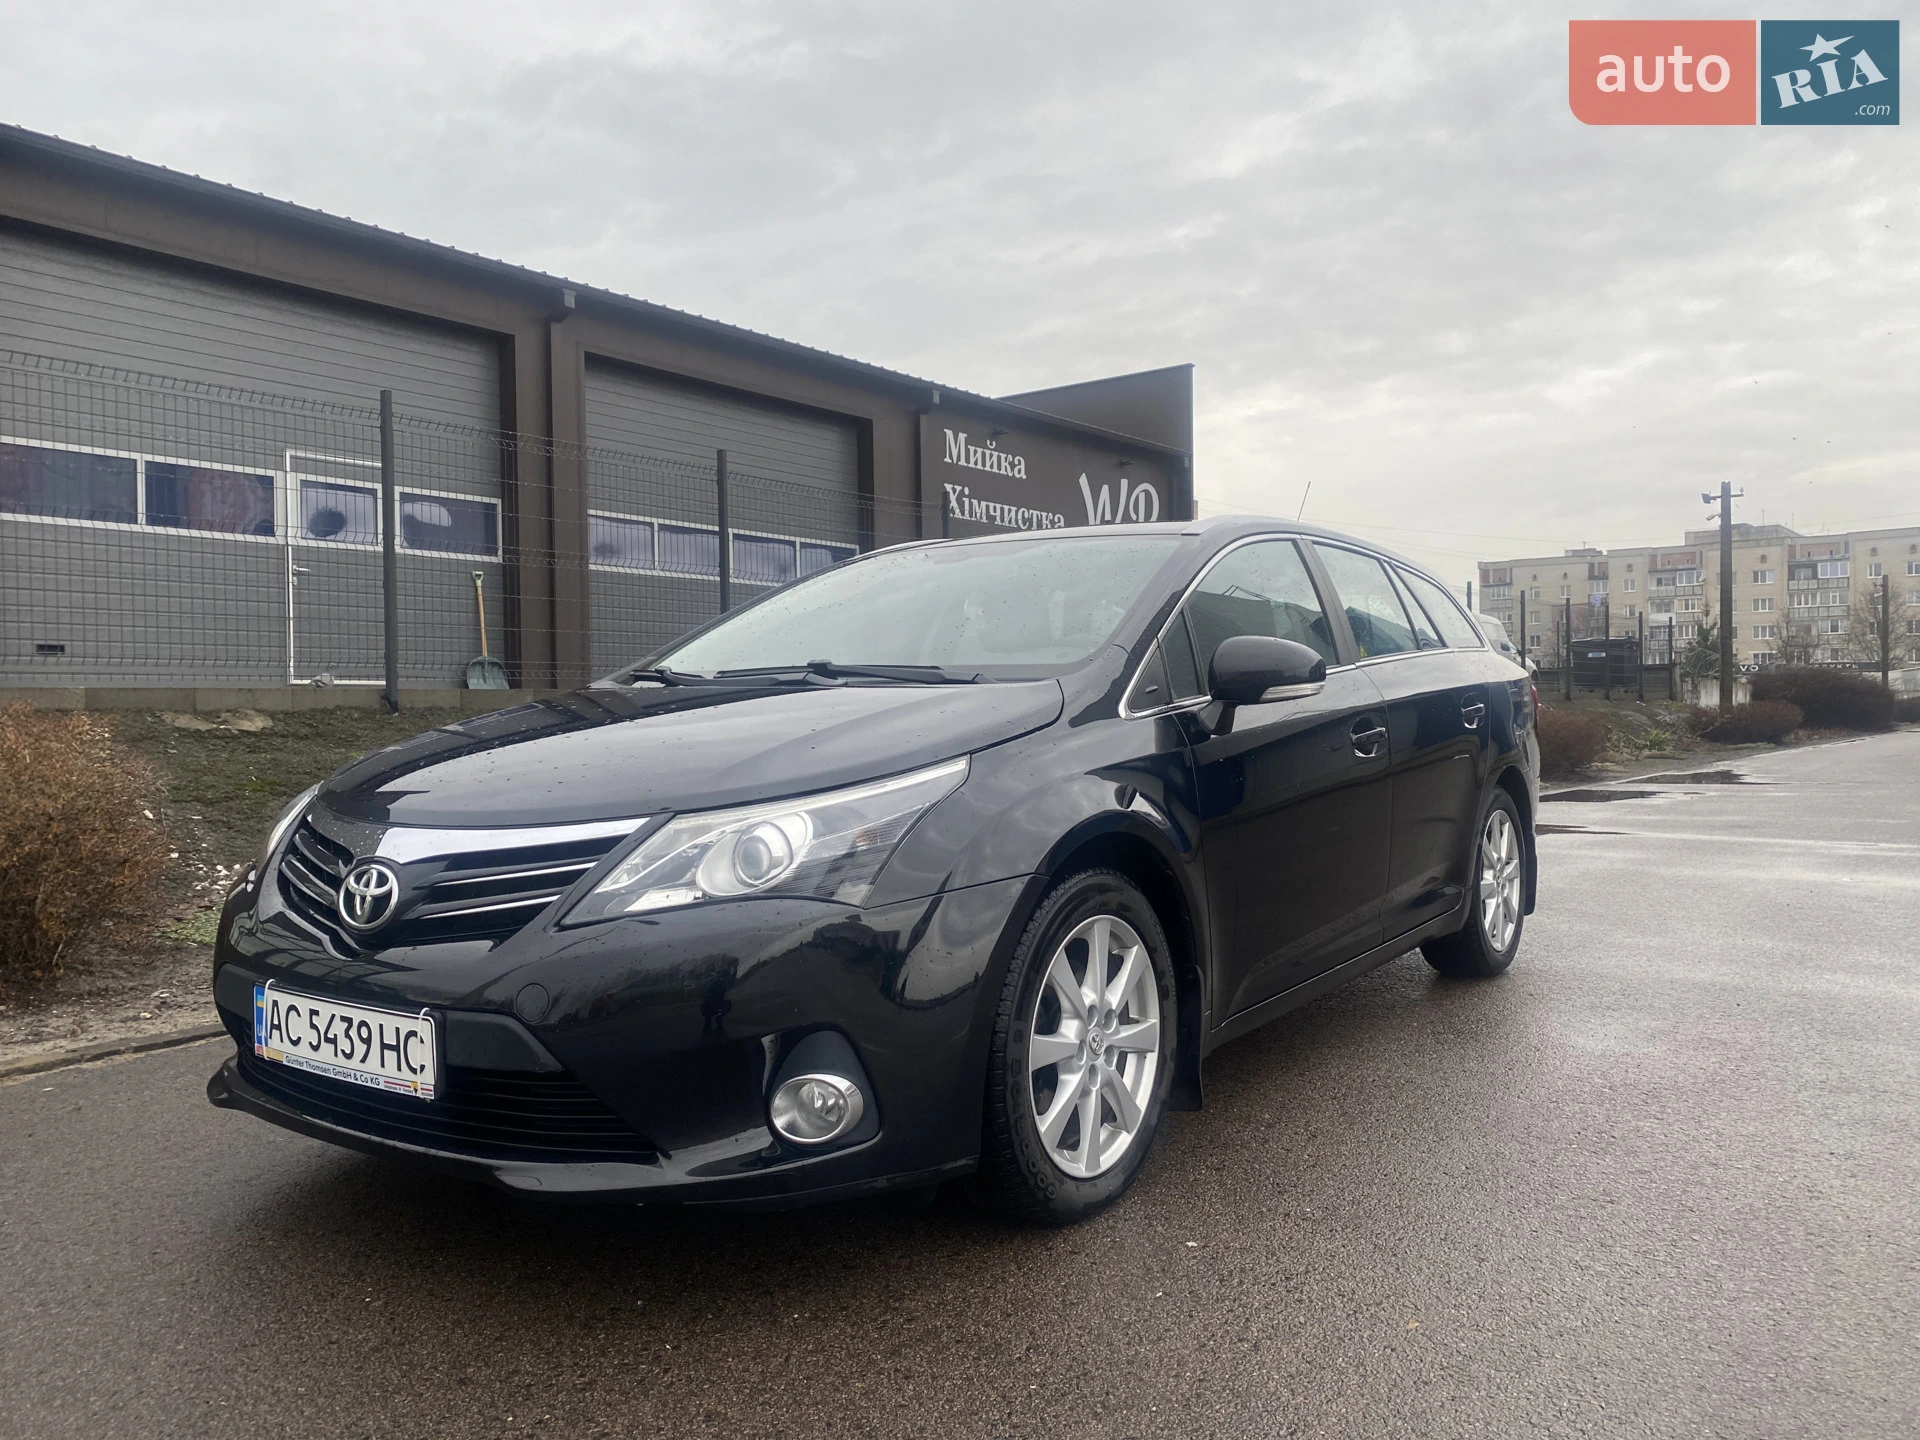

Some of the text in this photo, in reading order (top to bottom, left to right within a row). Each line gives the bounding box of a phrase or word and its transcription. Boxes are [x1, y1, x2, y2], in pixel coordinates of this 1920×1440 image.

[943, 428, 1027, 480] Мийка
[943, 483, 1065, 531] Хімчистка
[269, 999, 426, 1076] AC 5439 HC
[285, 1055, 381, 1086] Günter Thomsen GmbH & Co KG
